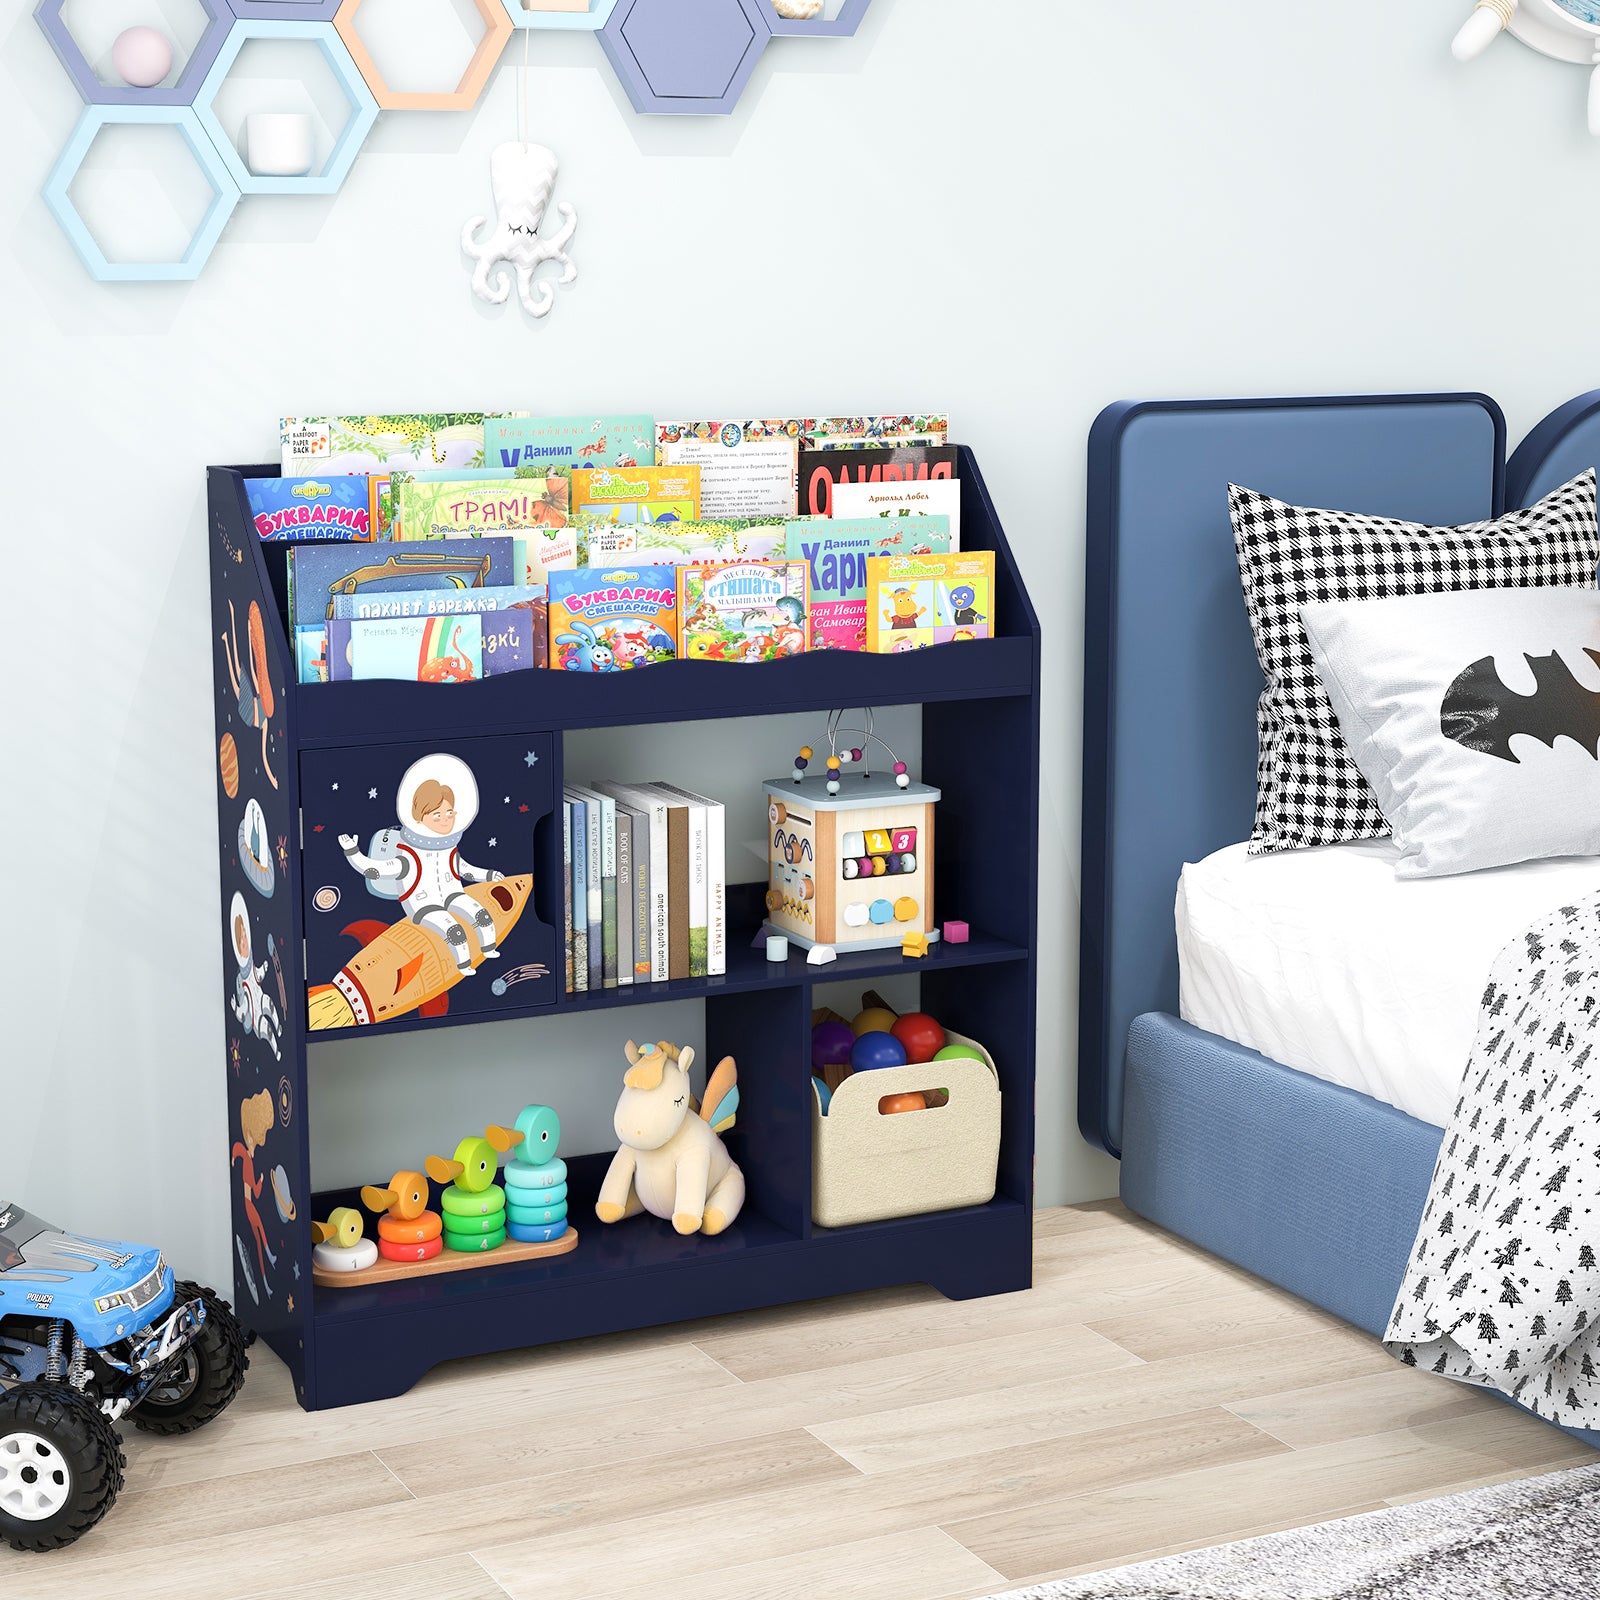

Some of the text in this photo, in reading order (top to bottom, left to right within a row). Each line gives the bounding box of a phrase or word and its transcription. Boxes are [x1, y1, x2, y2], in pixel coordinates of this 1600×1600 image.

[524, 444, 572, 460] Даниил
[293, 485, 330, 497] СМЕШАРИКИ
[590, 482, 648, 497] BACKYARDIGANS
[868, 492, 930, 503] Арнольд Лобел
[450, 496, 528, 522] ТРЯМ!
[254, 506, 369, 537] БУКВАРИК
[276, 527, 352, 540] СМЕШАРИК
[824, 539, 870, 550] Даниил
[724, 566, 766, 580] ВЕСЁЛЫЕ
[565, 588, 676, 612] БУКВАРИК
[718, 596, 775, 606] МАЛЫШАТАМ
[586, 604, 656, 616] СМЕШАРИК
[810, 607, 831, 617] ван
[620, 832, 628, 852] BOOK
[849, 836, 856, 850] 1
[872, 833, 884, 849] 2
[898, 833, 910, 850] 3
[620, 854, 628, 865] OF
[639, 891, 646, 900] OF
[657, 894, 667, 978] american south animals
[540, 1174, 554, 1186] 10
[481, 1202, 488, 1214] 6
[544, 1210, 552, 1222] 8
[482, 1220, 489, 1232] 5
[416, 1230, 424, 1242] 3
[544, 1229, 552, 1241] 7
[480, 1238, 488, 1250] 4
[416, 1248, 426, 1260] 2
[351, 1258, 357, 1269] 1
[26, 1293, 54, 1304] POWER
